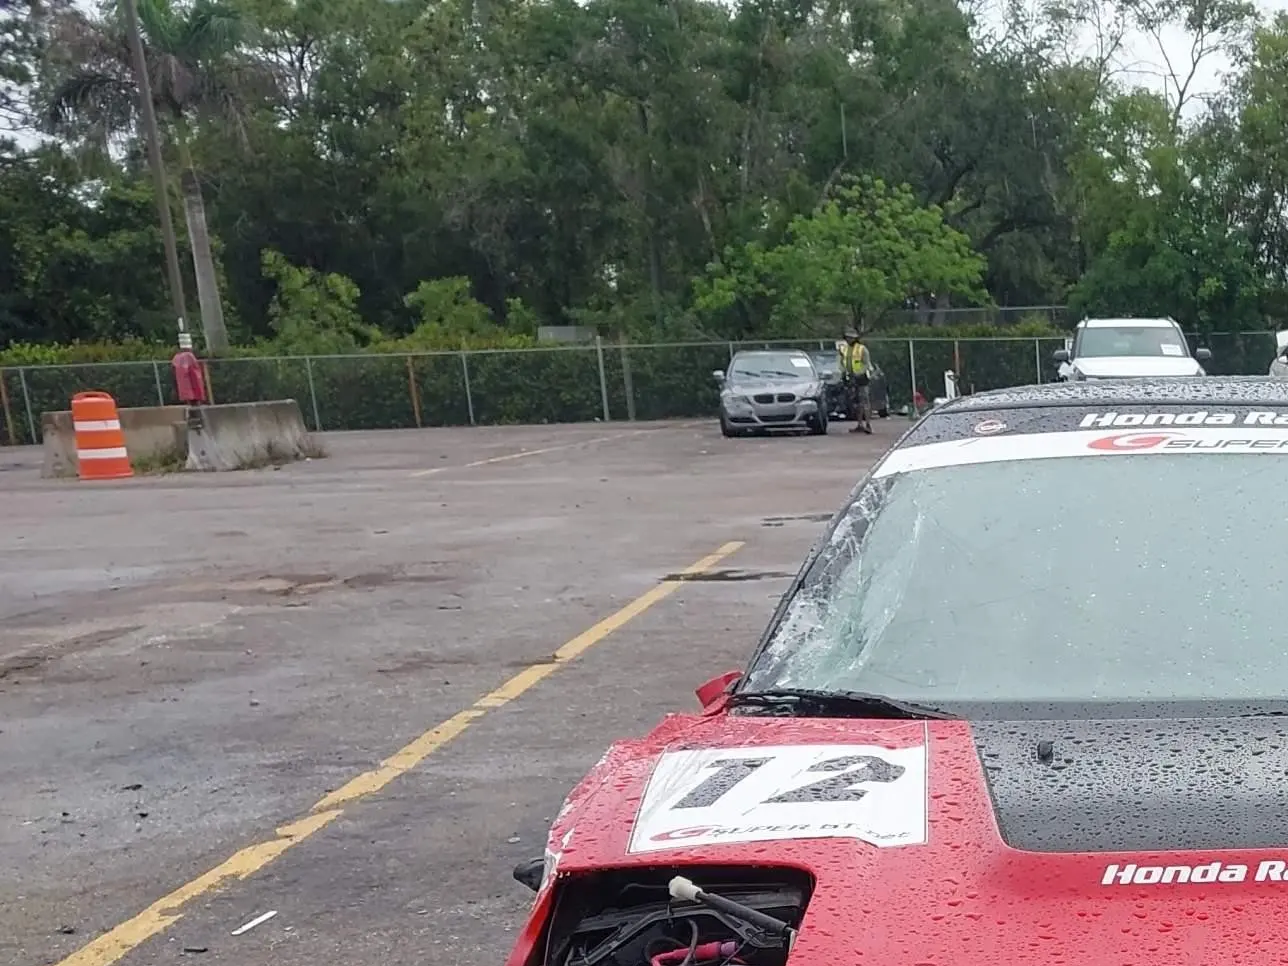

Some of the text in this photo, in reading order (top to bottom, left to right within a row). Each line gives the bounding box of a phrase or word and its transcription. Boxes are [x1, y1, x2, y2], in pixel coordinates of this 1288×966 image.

[1079, 411, 1237, 428] Honda
[711, 824, 811, 838] SUPER
[1101, 861, 1249, 885] Honda
